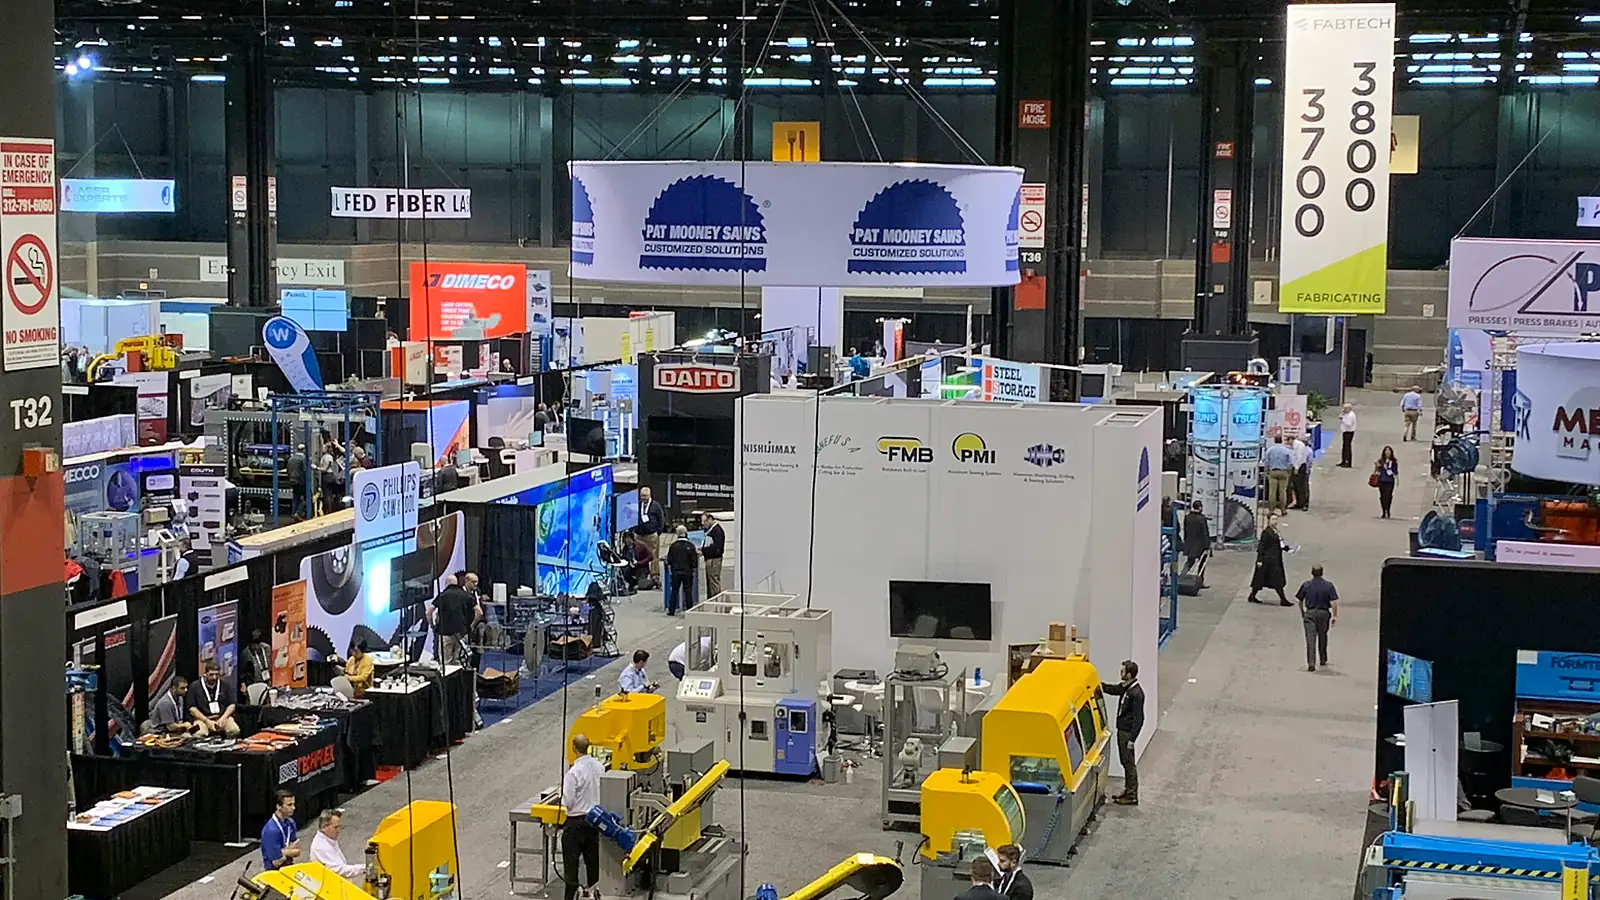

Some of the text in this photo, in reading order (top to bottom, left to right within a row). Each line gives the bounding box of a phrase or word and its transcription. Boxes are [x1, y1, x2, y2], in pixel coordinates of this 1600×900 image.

[1313, 17, 1391, 30] FABTECH
[1024, 103, 1045, 113] FIRE
[1023, 114, 1047, 124] HOSE
[1345, 62, 1377, 213] 3800
[3, 154, 49, 168] IN CASE OF
[1294, 89, 1326, 238] 3700
[2, 170, 52, 183] EMERGENCY
[344, 193, 376, 211] FED
[386, 194, 446, 212] FIBER
[646, 224, 761, 241] PAT MOONEY SAWS
[855, 228, 962, 244] PAT MOONEY SAWS
[644, 243, 764, 255] CUSTOMIZED SOLUTIONS
[853, 247, 964, 258] CUSTOMIZED SOLUTIONS
[1021, 252, 1042, 263] T36
[304, 262, 337, 278] Exit
[441, 274, 516, 290] DIMECO
[1297, 293, 1381, 304] FABRICATING
[1468, 316, 1507, 325] PRESSES
[1513, 317, 1541, 326] PRESS
[1543, 318, 1579, 328] BRAKES
[5, 326, 57, 345] NO SMOKING
[660, 369, 733, 388] DAITO
[993, 366, 1022, 381] STEEL
[992, 380, 1037, 399] STORAGE
[10, 395, 53, 430] T32
[743, 440, 796, 454] NISHIJIMAX
[888, 446, 933, 463] FMB
[960, 449, 996, 464] PMI
